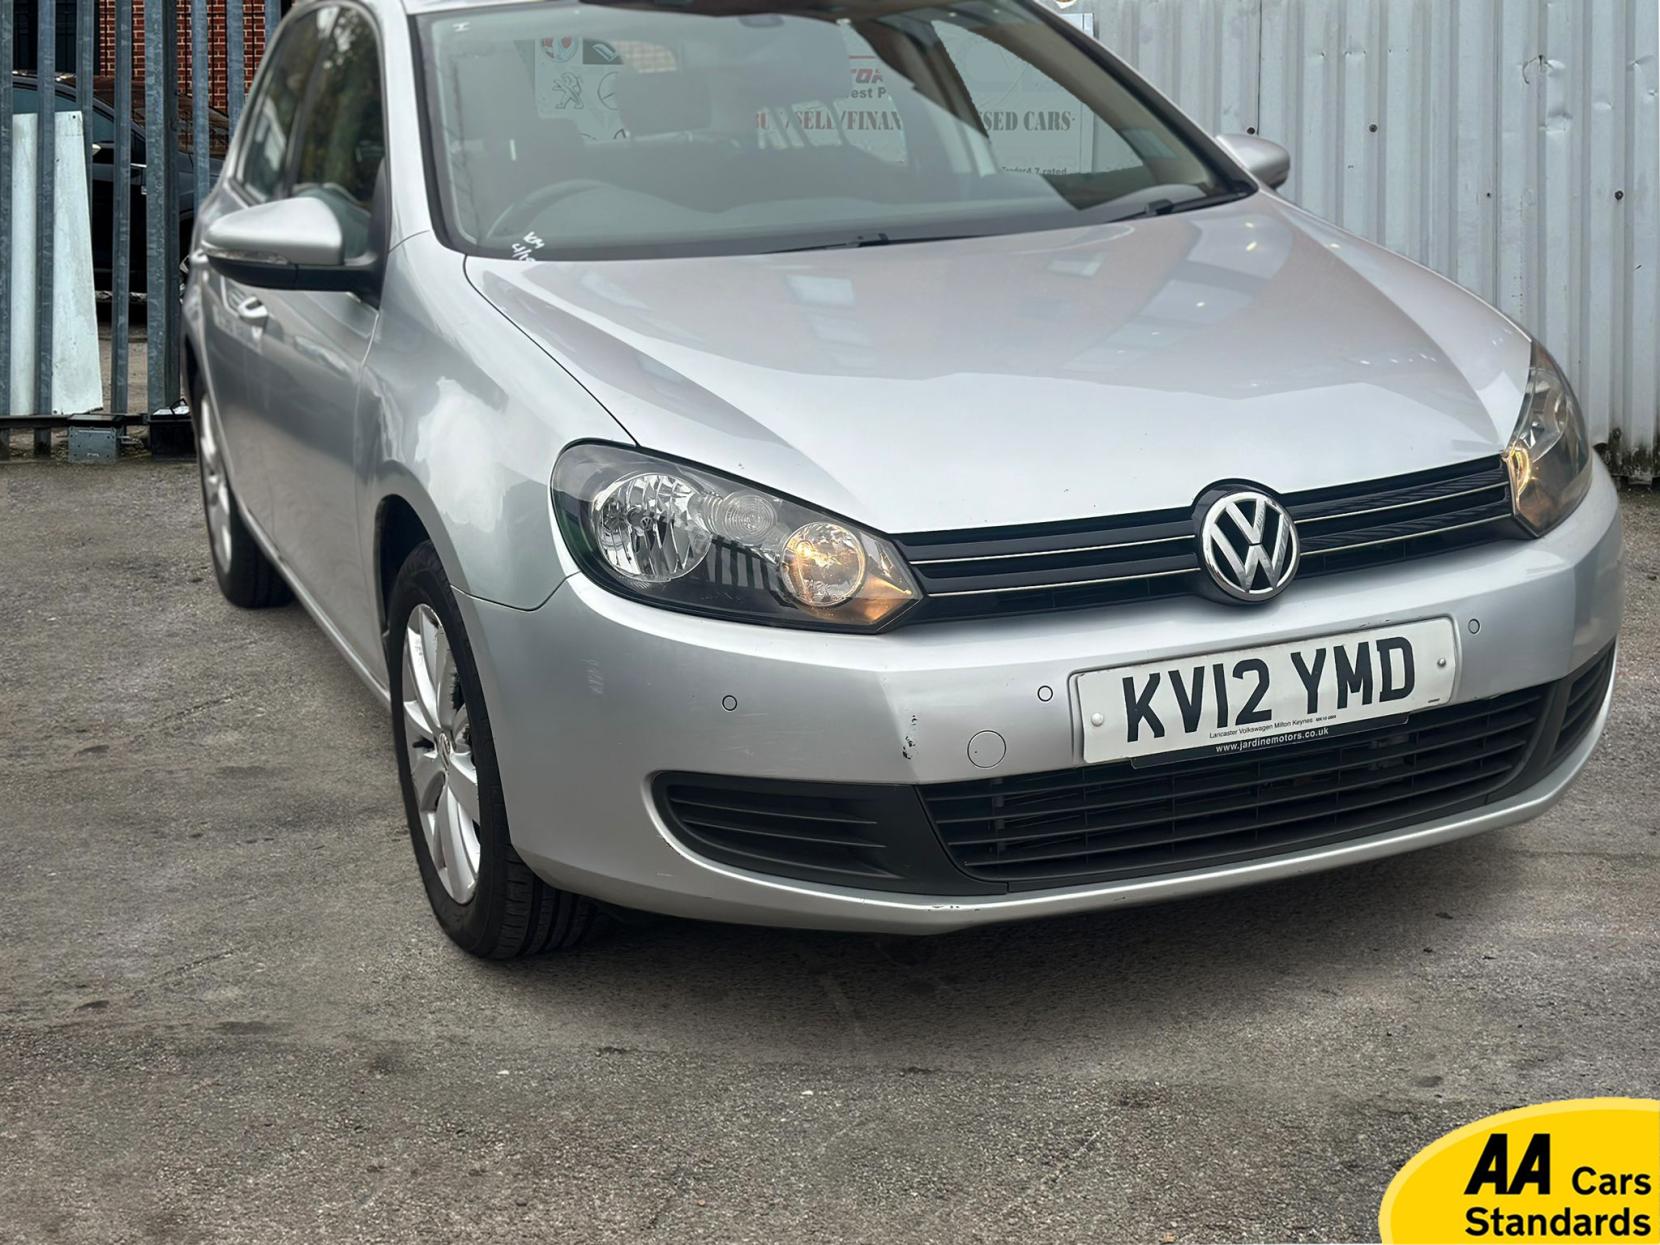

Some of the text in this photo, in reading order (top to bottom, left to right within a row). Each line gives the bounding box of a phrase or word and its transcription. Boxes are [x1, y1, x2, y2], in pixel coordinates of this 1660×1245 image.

[850, 88, 873, 99] est
[981, 111, 1018, 131] SED
[1122, 636, 1416, 743] KV12 YMD
[1209, 728, 1238, 739] Lancaster
[1238, 723, 1274, 735] Volkswagen
[1274, 720, 1292, 728] Milton
[1215, 727, 1329, 753] www.jardinemotors.co.uk
